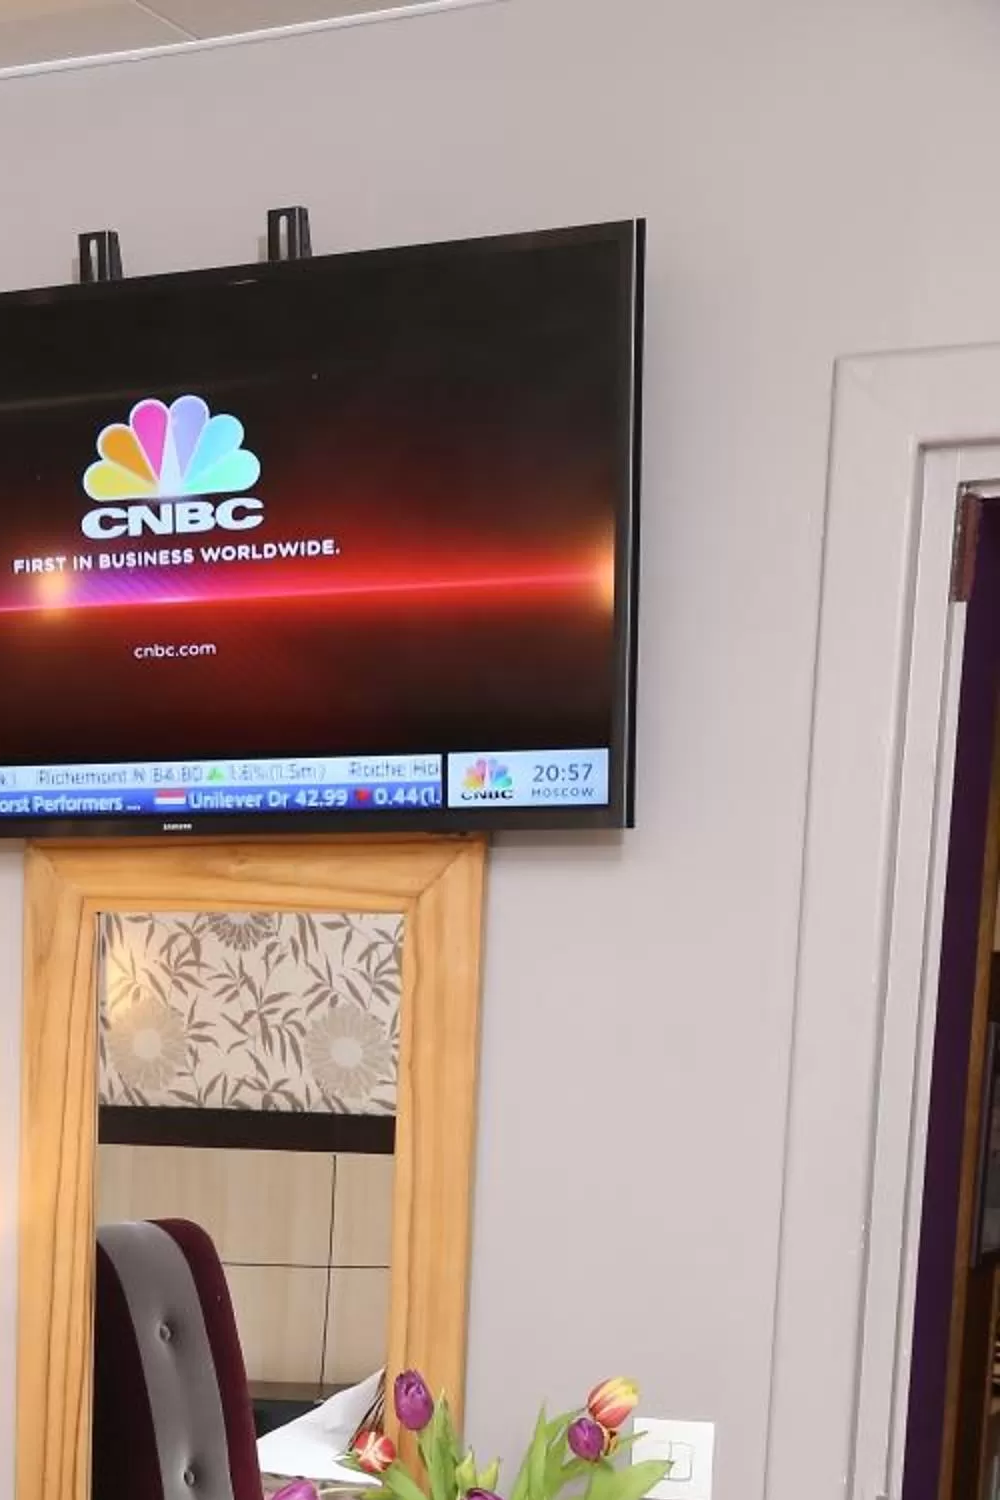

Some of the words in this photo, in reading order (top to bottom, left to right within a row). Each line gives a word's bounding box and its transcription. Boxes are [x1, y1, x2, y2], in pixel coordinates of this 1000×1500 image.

[81, 497, 264, 539] CNBC
[13, 556, 67, 575] FIRST
[73, 553, 93, 571] IN
[99, 548, 195, 570] BUSINESS
[200, 539, 341, 563] WORLDWIDE.
[133, 641, 217, 659] cnbc.com
[531, 762, 594, 783] 20:57
[191, 791, 265, 810] Unilever
[531, 786, 596, 799] MOSCOW
[32, 794, 124, 813] Performers
